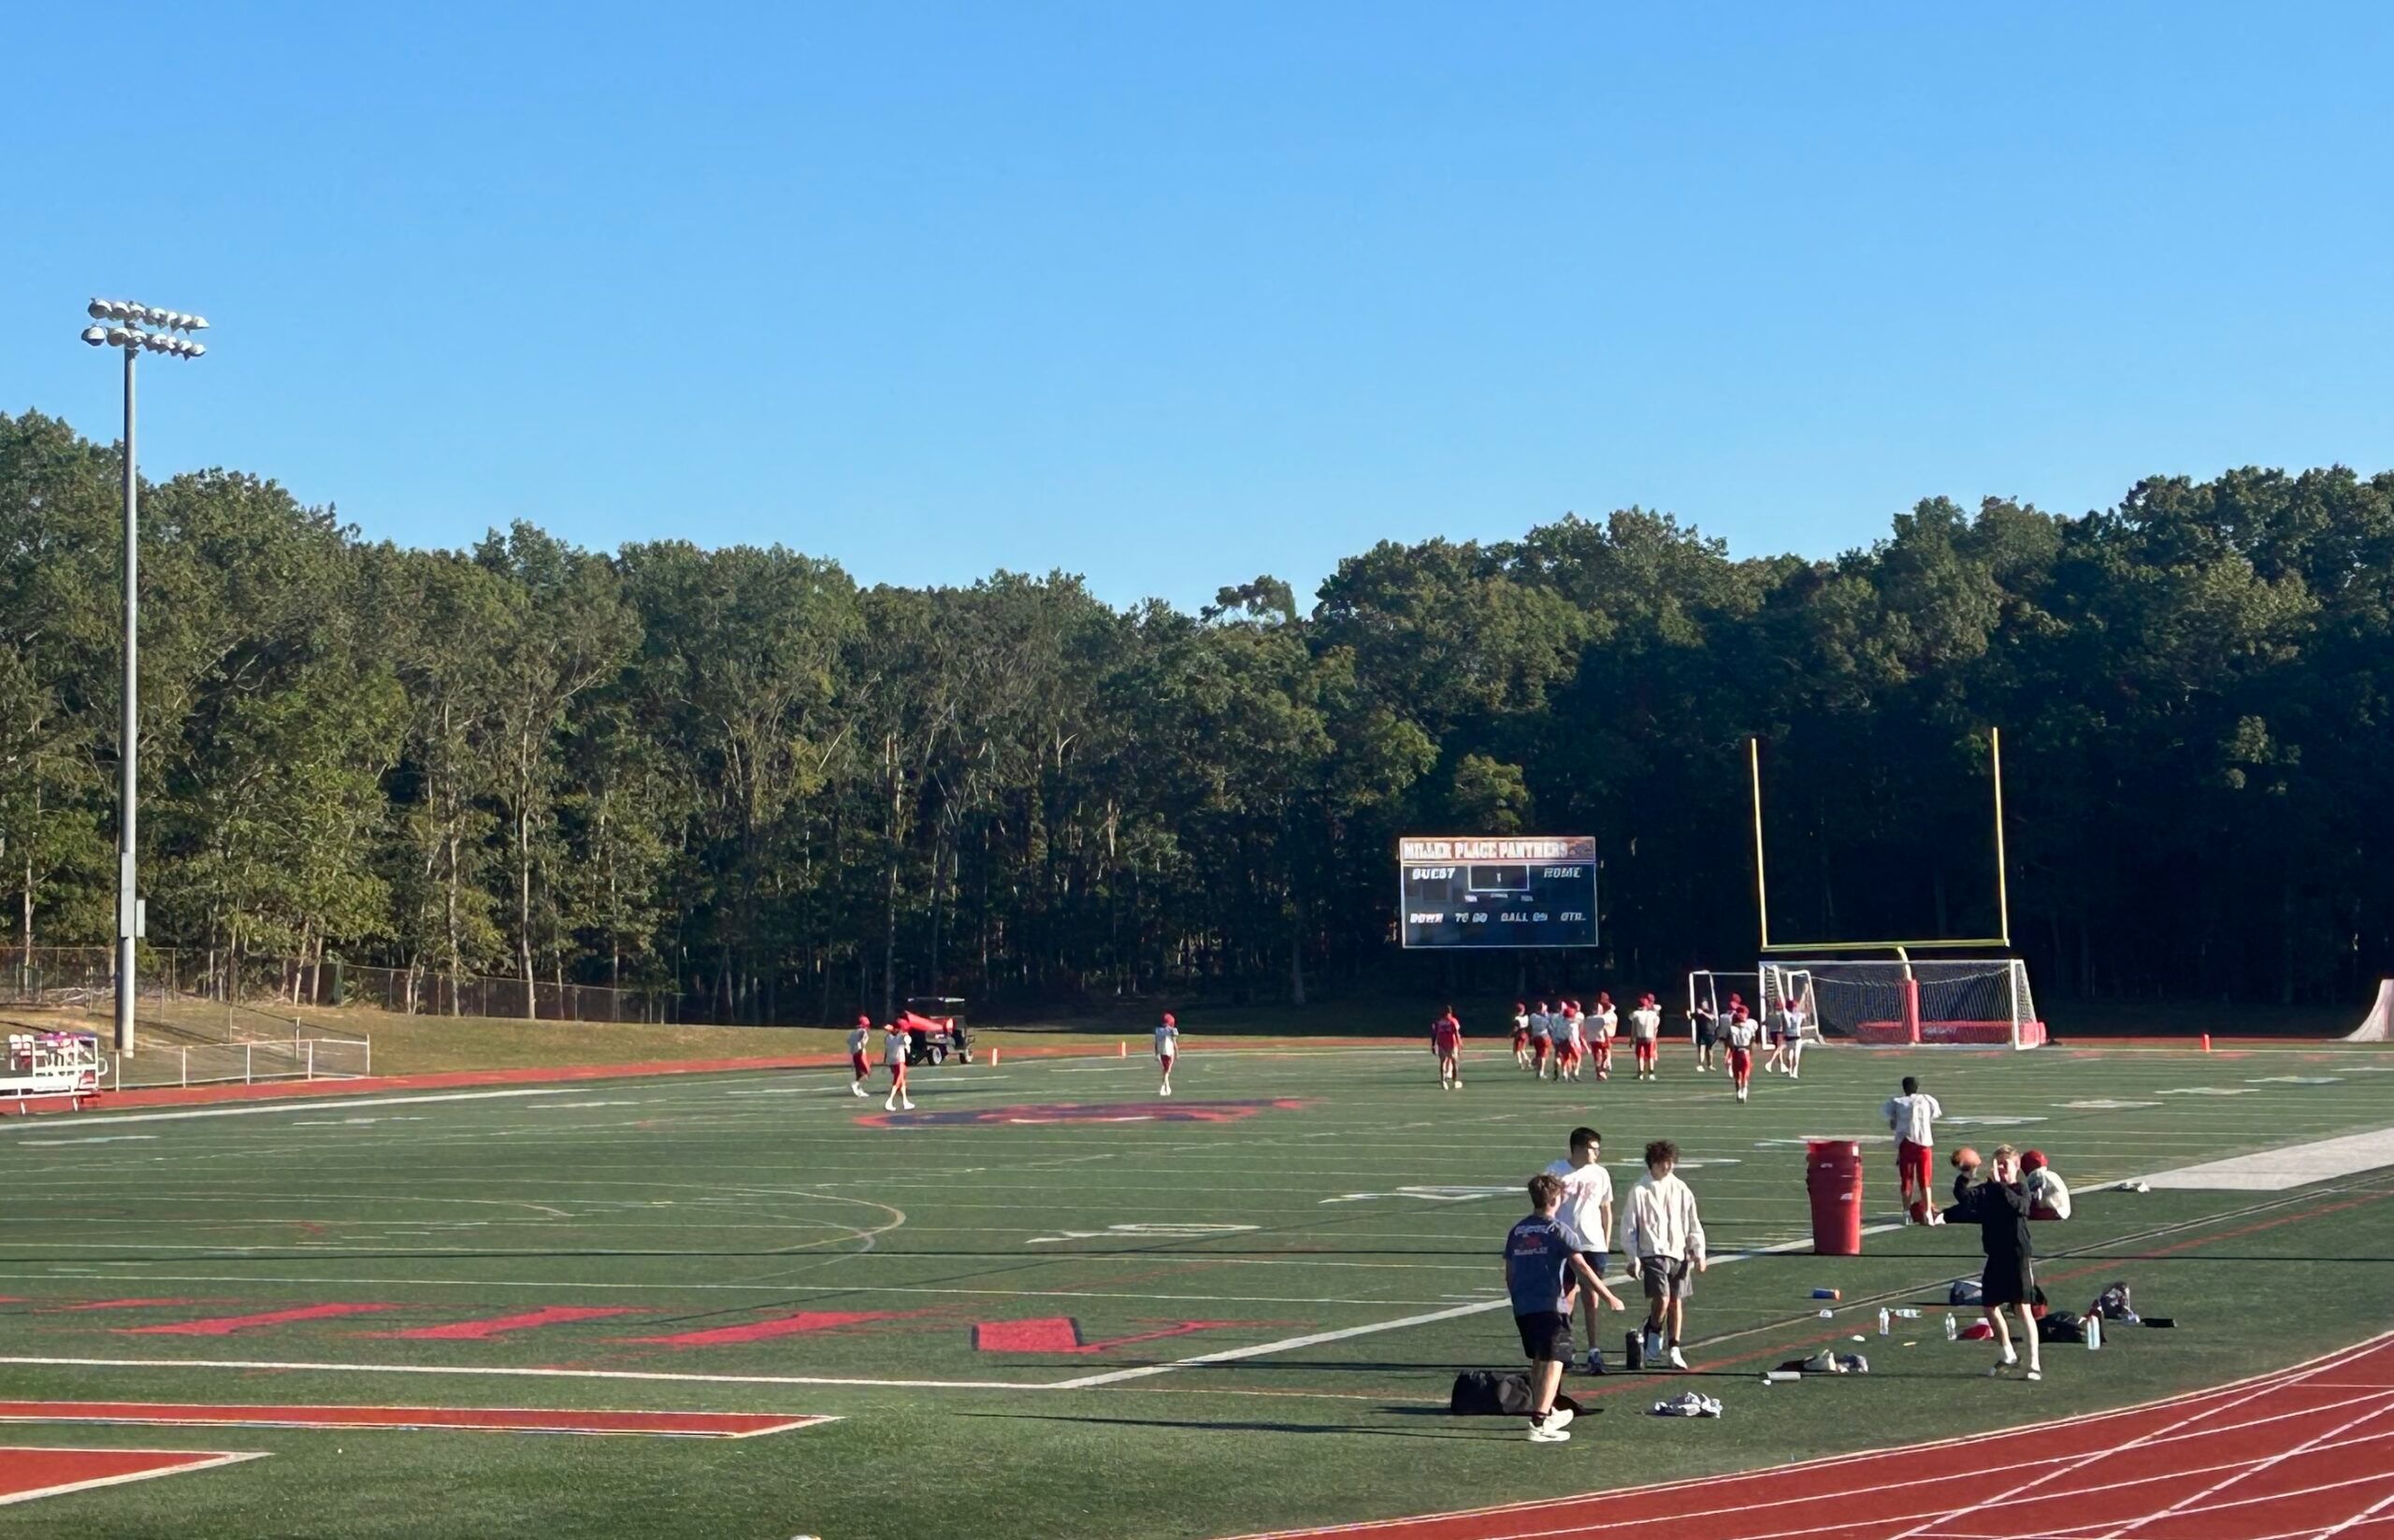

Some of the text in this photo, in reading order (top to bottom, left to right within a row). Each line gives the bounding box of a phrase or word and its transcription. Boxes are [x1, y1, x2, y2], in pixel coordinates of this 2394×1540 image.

[1404, 842, 1568, 859] MILLER PLACE PANTHERS
[1412, 868, 1456, 880] GUEST
[1543, 867, 1582, 879] HOME
[1409, 913, 1444, 924] DOWN
[1455, 913, 1469, 923] TO
[1500, 912, 1529, 922] BALL
